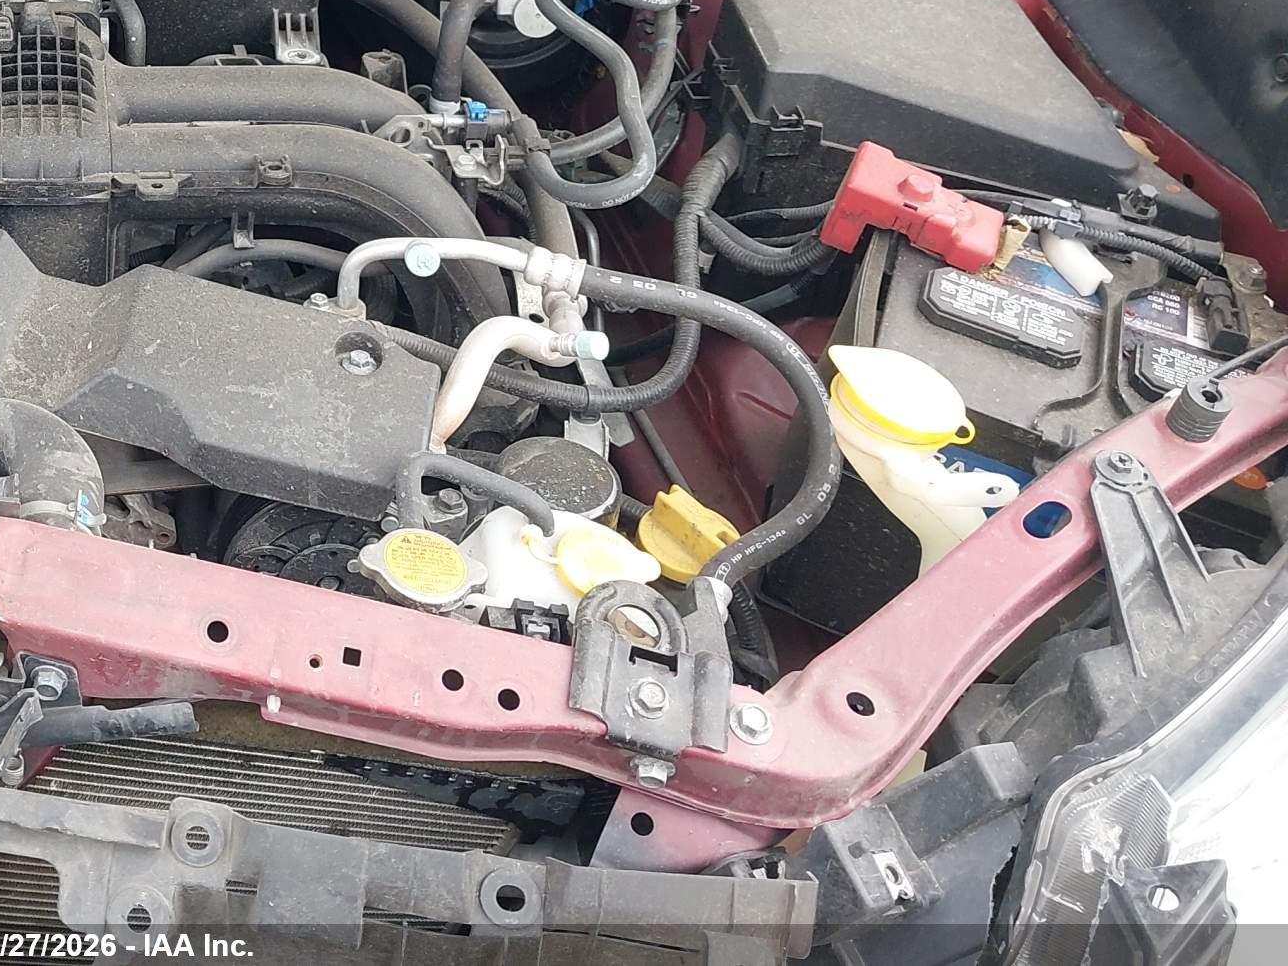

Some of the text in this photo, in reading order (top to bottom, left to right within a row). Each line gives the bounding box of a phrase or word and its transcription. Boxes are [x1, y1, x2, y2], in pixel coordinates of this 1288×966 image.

[959, 275, 1009, 297] DANGER
[1021, 296, 1066, 317] POISON
[730, 553, 743, 564] HP
[744, 529, 787, 556] HFC-134a
